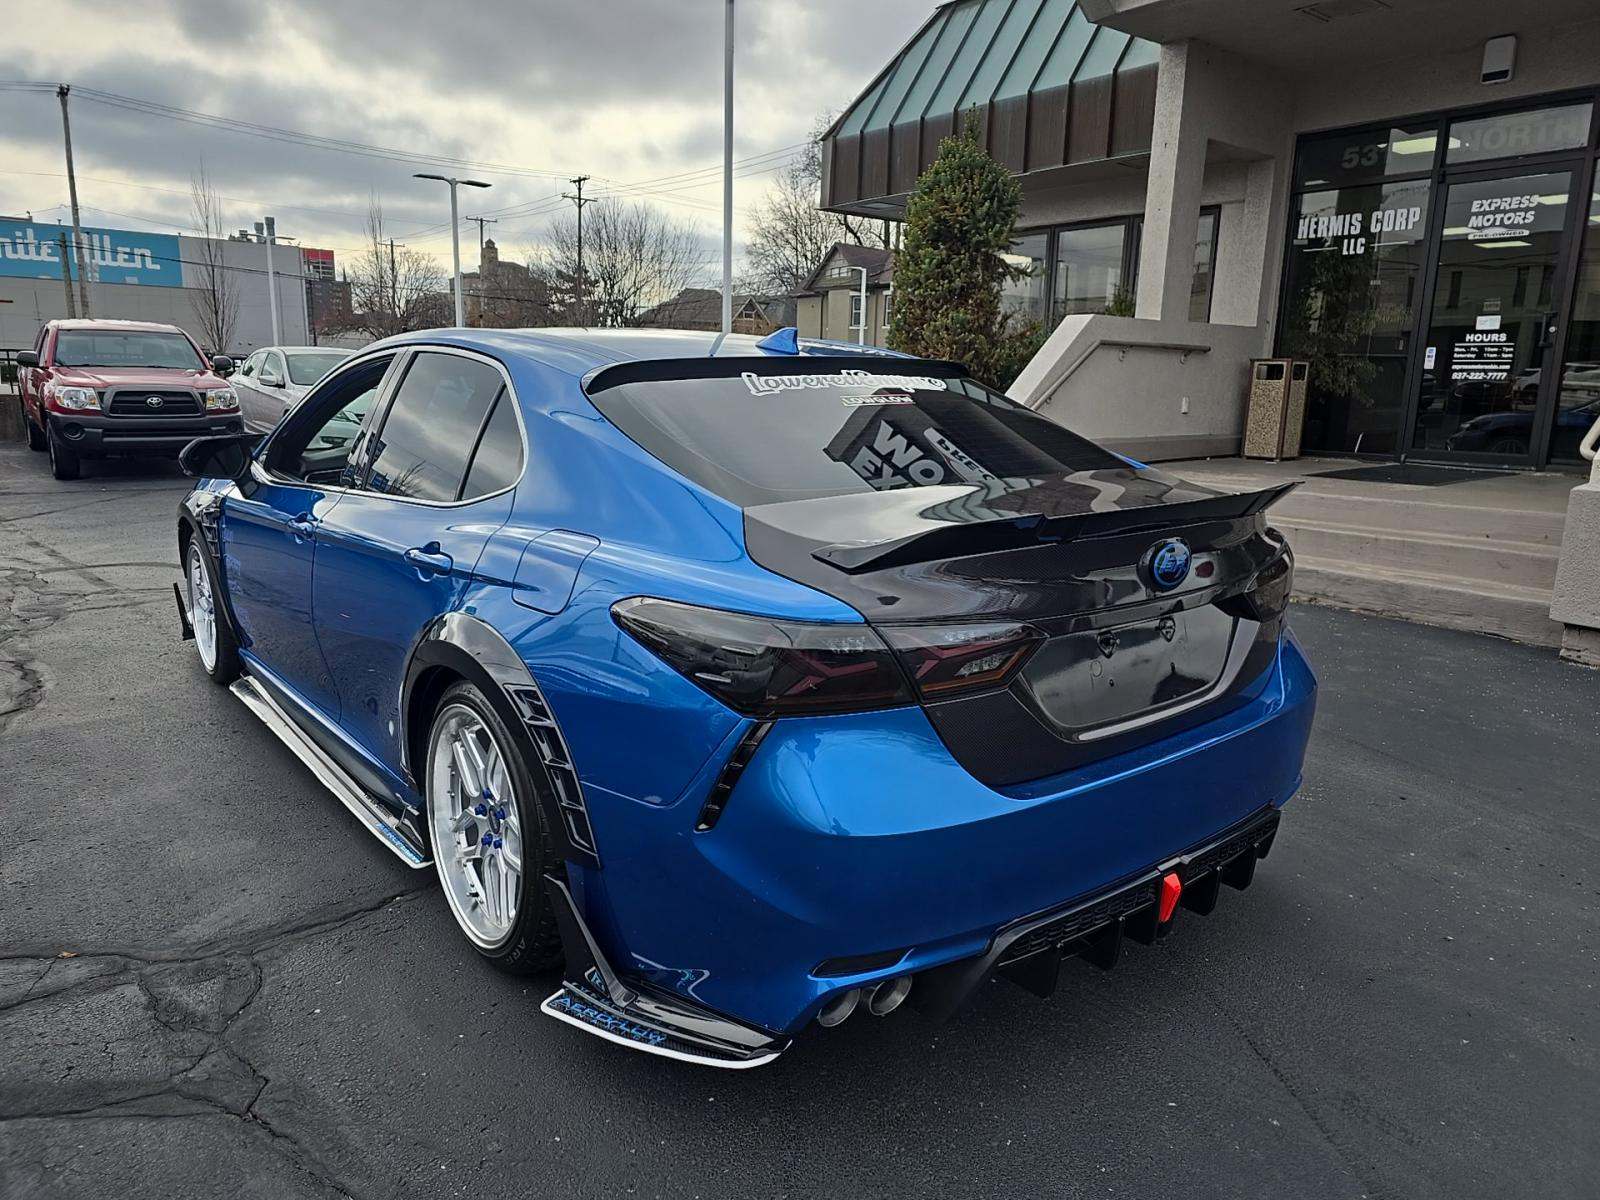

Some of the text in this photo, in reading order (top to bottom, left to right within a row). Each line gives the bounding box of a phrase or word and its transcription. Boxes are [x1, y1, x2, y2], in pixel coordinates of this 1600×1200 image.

[1471, 194, 1540, 213] EXPRESS
[1297, 207, 1420, 240] HERMIS CORP
[1468, 210, 1535, 228] MOTORS
[1341, 238, 1366, 256] LLC
[1465, 333, 1507, 342] HOURS
